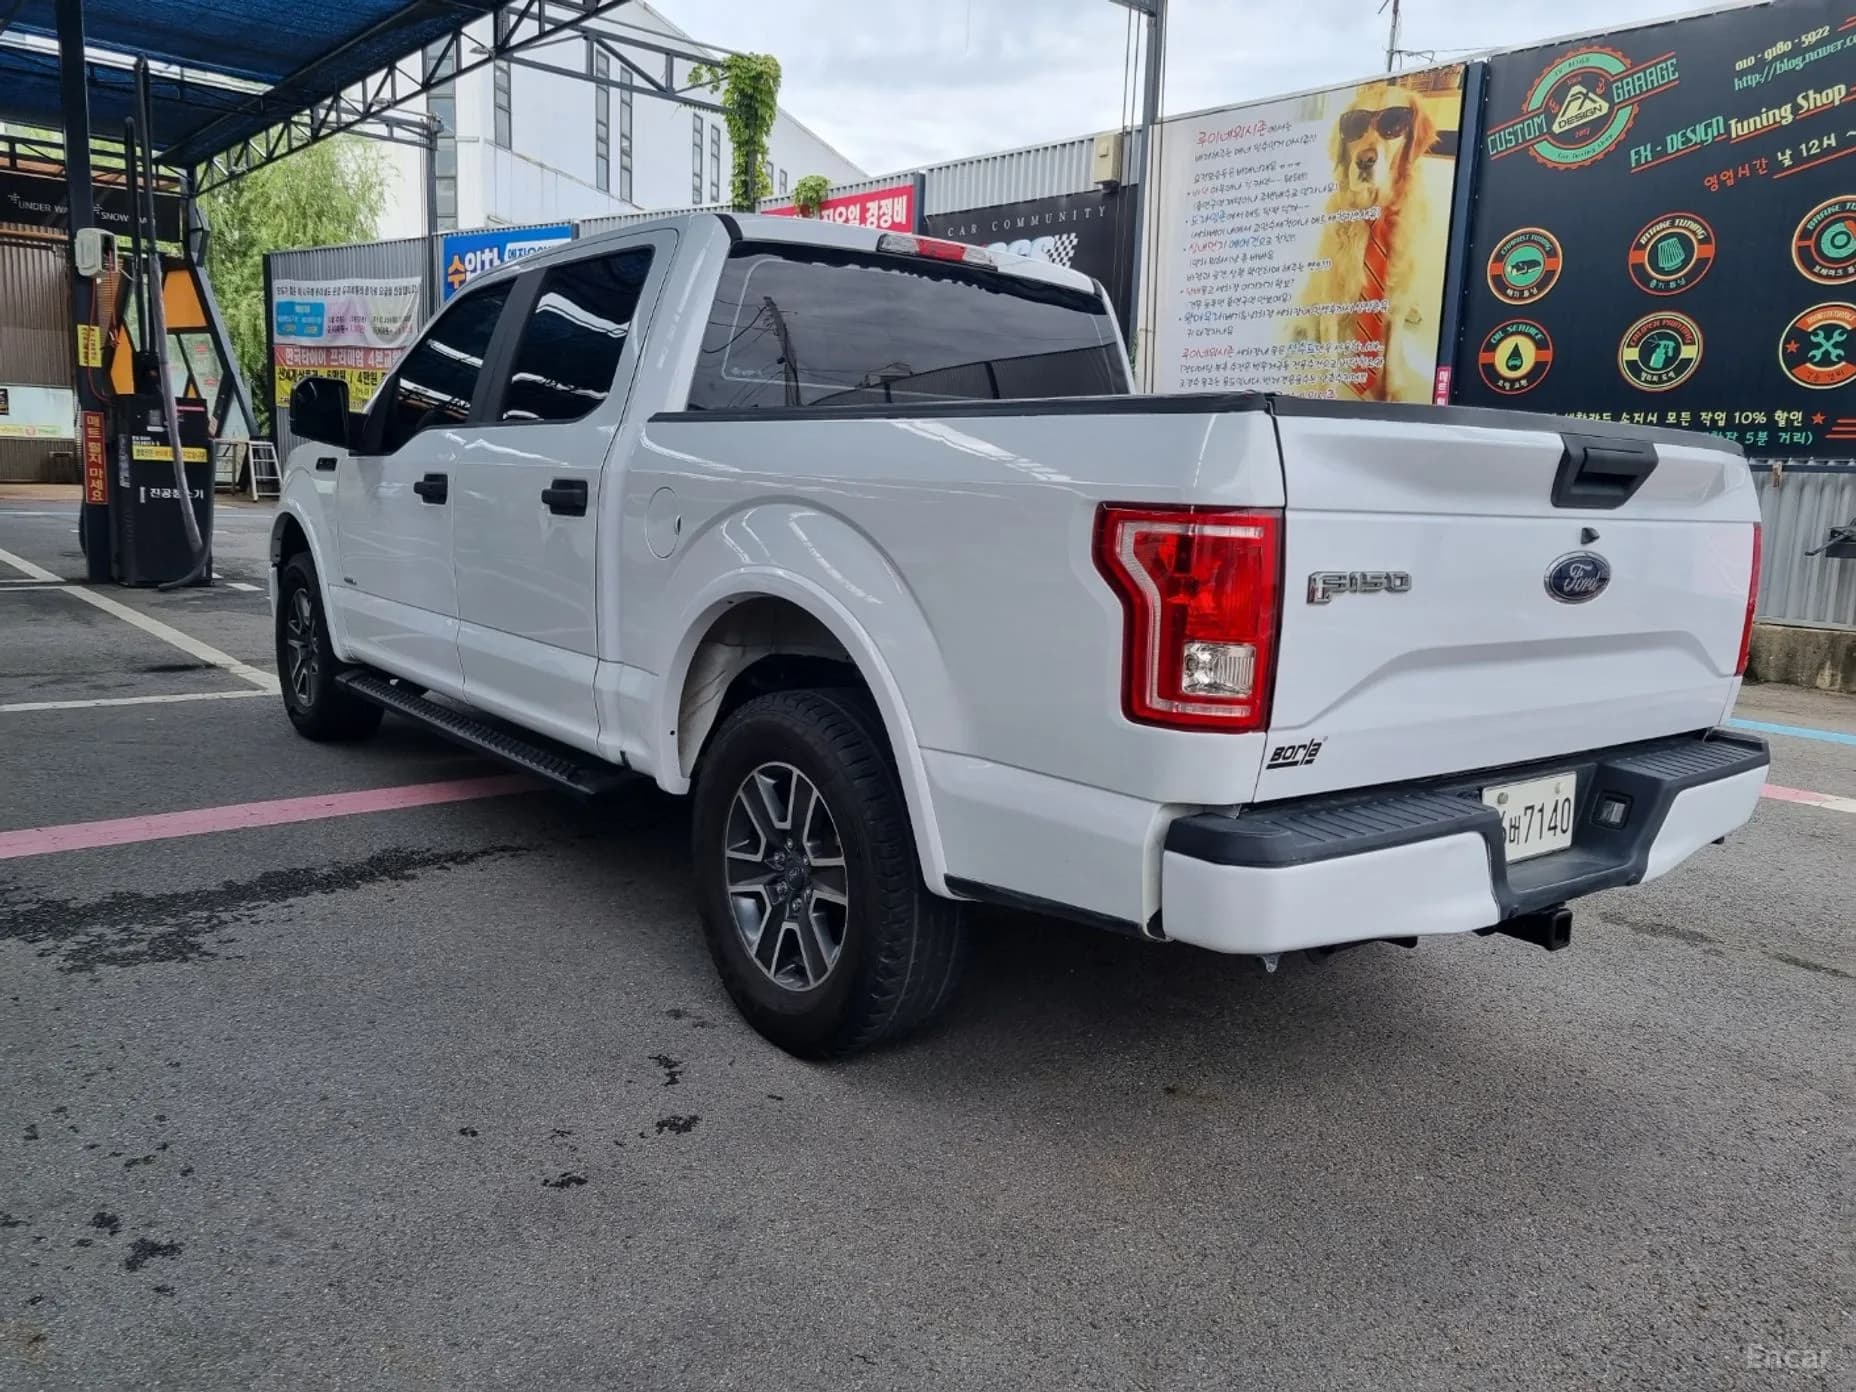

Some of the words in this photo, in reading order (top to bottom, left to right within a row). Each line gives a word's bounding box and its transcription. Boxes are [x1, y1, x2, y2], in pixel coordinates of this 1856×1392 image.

[1487, 114, 1548, 155] CUSTOM
[1612, 57, 1679, 103] GARAGE
[1558, 104, 1602, 128] DESIGN
[1728, 103, 1794, 139] Tuning
[1796, 84, 1847, 114] Shop
[1704, 157, 1769, 192] 영업시간
[1777, 148, 1793, 167] 낮
[1800, 133, 1837, 157] 12시
[18, 200, 50, 212] UNDER
[101, 211, 129, 222] SNOW
[947, 224, 977, 237] CAR
[992, 206, 1106, 232] COMMUNITY
[1665, 411, 1691, 426] 모든
[1700, 411, 1727, 427] 작업
[1734, 411, 1767, 425] 10%
[1774, 410, 1803, 427] 할인
[1745, 431, 1769, 446] 5분
[1778, 431, 1813, 445] 거리)
[1563, 563, 1601, 592] Ford
